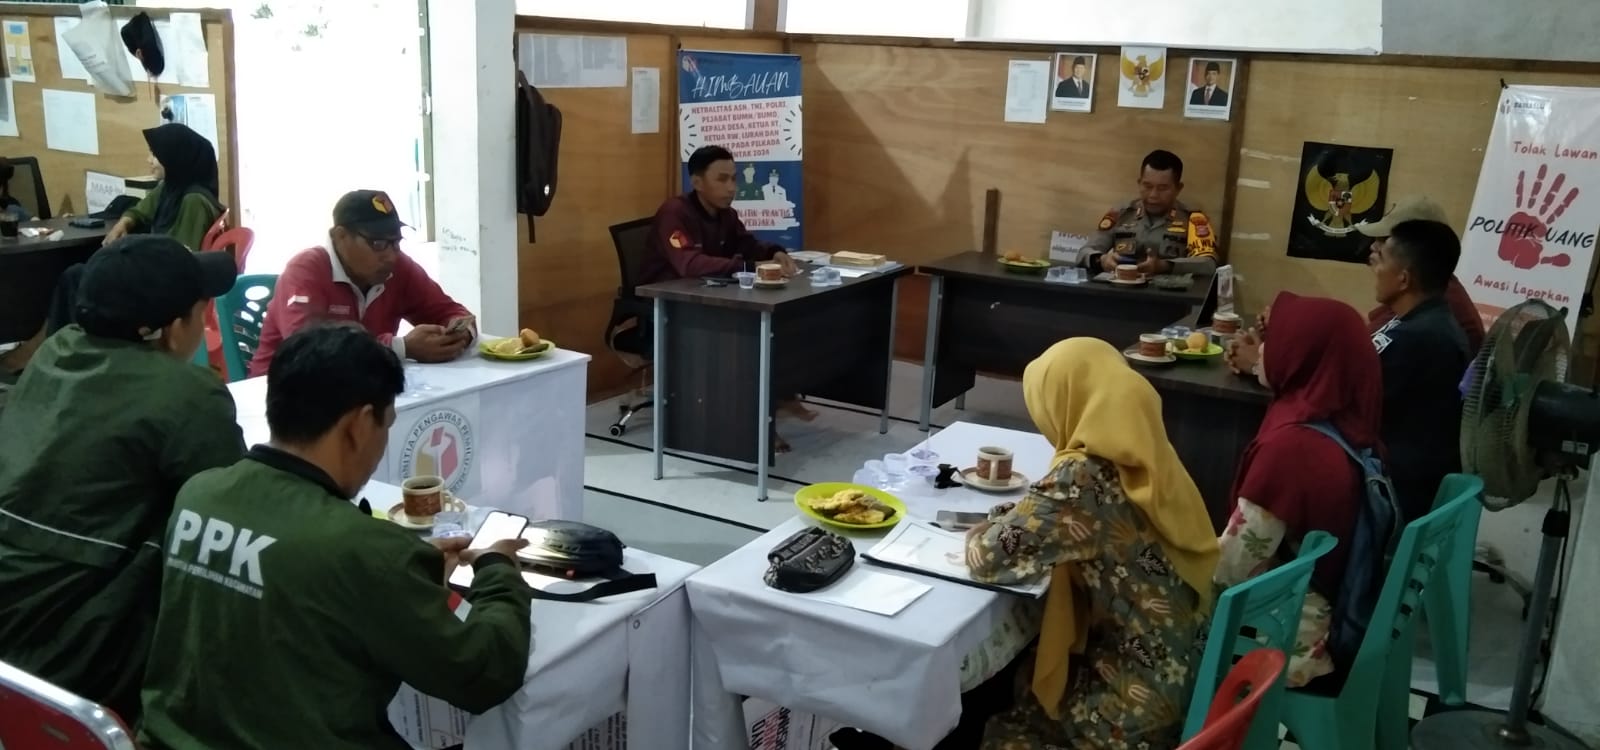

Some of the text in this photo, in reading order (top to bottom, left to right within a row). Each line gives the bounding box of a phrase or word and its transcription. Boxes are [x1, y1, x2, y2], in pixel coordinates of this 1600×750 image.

[691, 71, 790, 99] HIMBAUAN
[701, 124, 726, 133] KEPALA
[747, 121, 769, 129] KETUA
[704, 134, 726, 142] KETUA
[742, 131, 763, 139] LURAH
[764, 130, 779, 138] DAN
[731, 140, 750, 149] PADA
[751, 138, 780, 147] PILKADA
[1513, 141, 1598, 159] Tolak Lawan
[1469, 216, 1595, 248] POLITIK UANG
[1473, 274, 1570, 303] Awasi Laporkan
[413, 412, 462, 437] PENGAWAS
[170, 508, 278, 586] PPK
